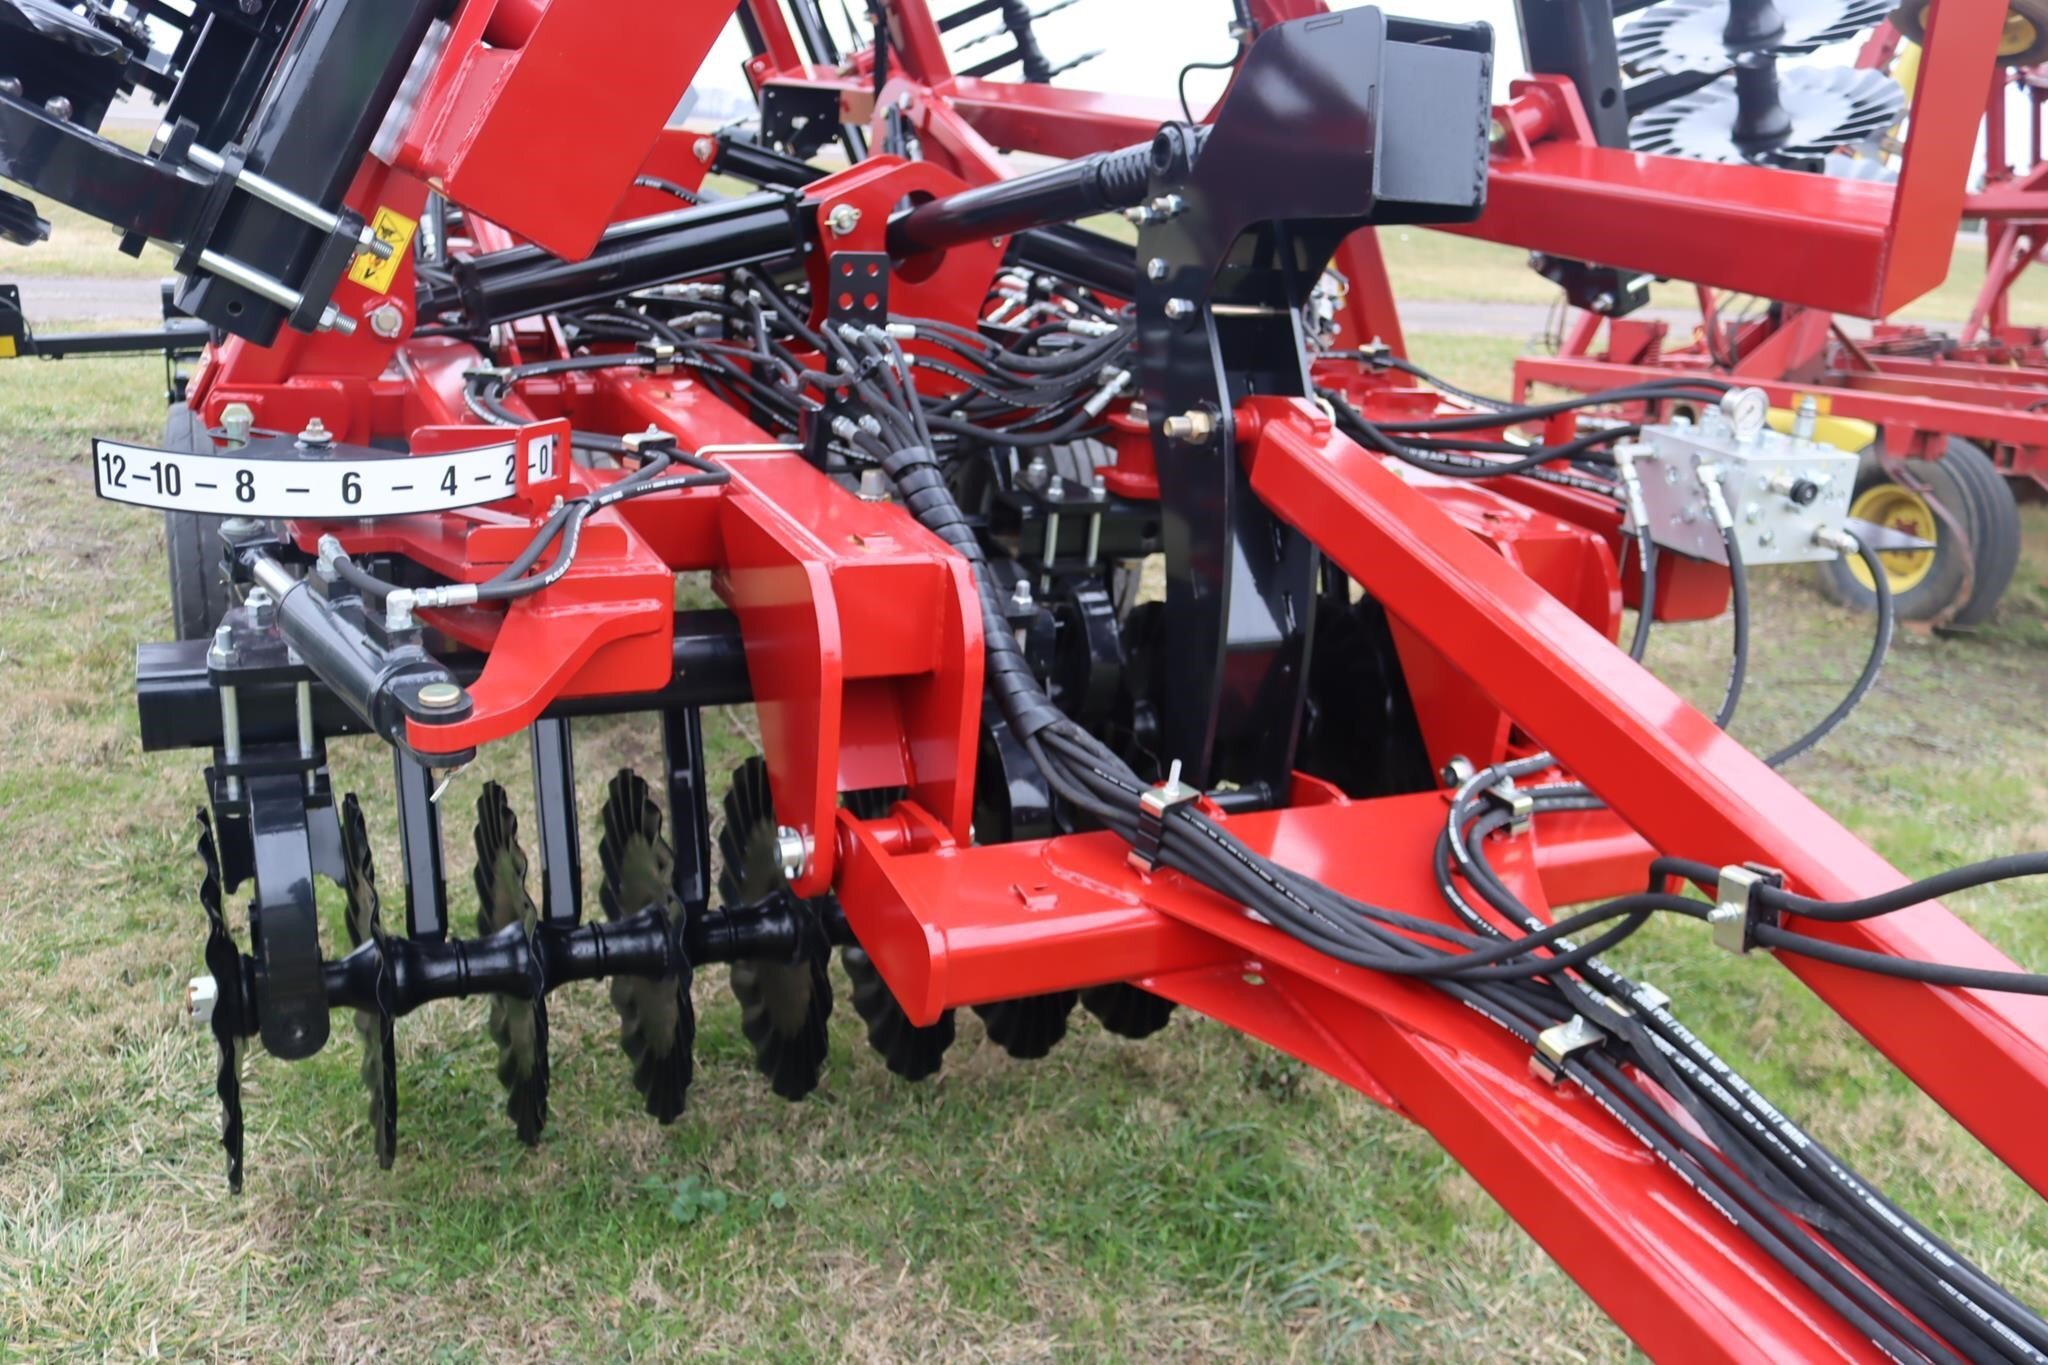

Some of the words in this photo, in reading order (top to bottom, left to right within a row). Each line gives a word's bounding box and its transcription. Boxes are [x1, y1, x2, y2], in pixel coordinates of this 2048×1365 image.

[101, 452, 128, 488] 12
[150, 461, 182, 497] 10
[235, 469, 256, 503] 8
[341, 471, 363, 504] 6
[440, 465, 458, 496] 4
[505, 454, 516, 486] 2
[539, 444, 548, 475] 0
